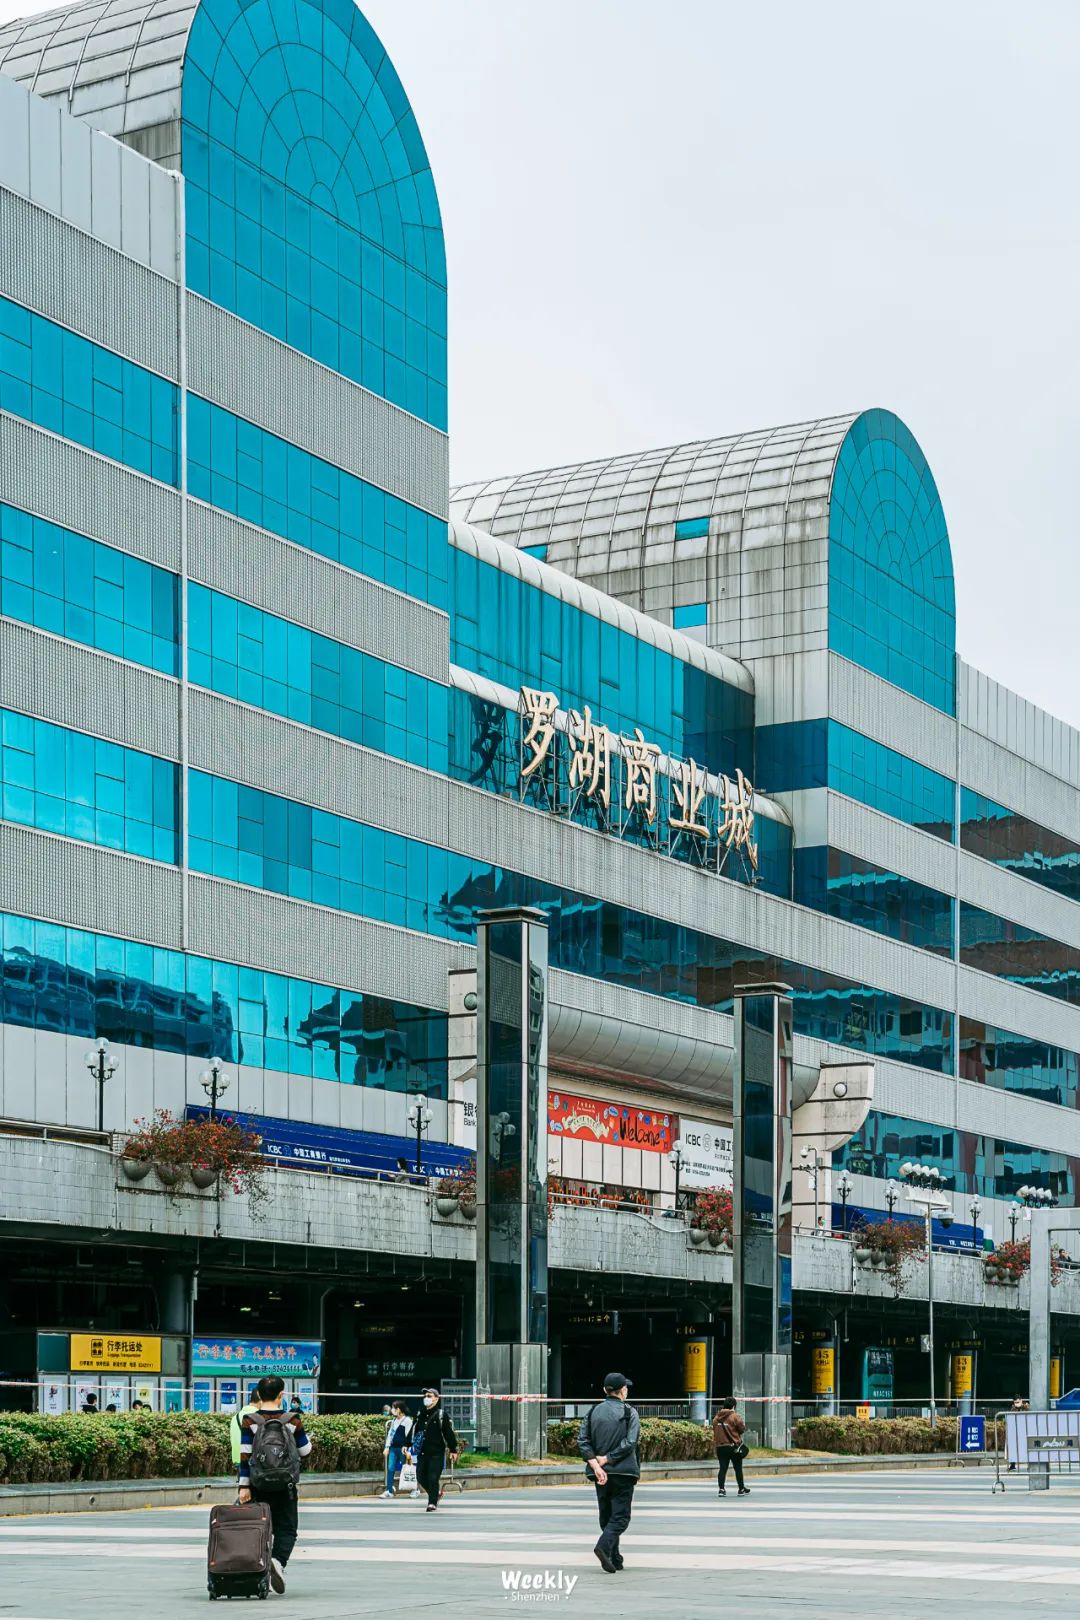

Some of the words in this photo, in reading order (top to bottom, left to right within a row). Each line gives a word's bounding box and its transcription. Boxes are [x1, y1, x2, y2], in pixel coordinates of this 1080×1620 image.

[520, 686, 758, 871] 罗湖商业城
[619, 1116, 660, 1147] Welcome
[685, 1133, 701, 1147] ICBC
[714, 1137, 733, 1152] 中国工
[267, 1145, 282, 1154] ICBC
[293, 1147, 326, 1160] 中国工商银行
[107, 1340, 142, 1352] 行李托运处
[688, 1345, 700, 1355] 16
[816, 1350, 829, 1360] 15
